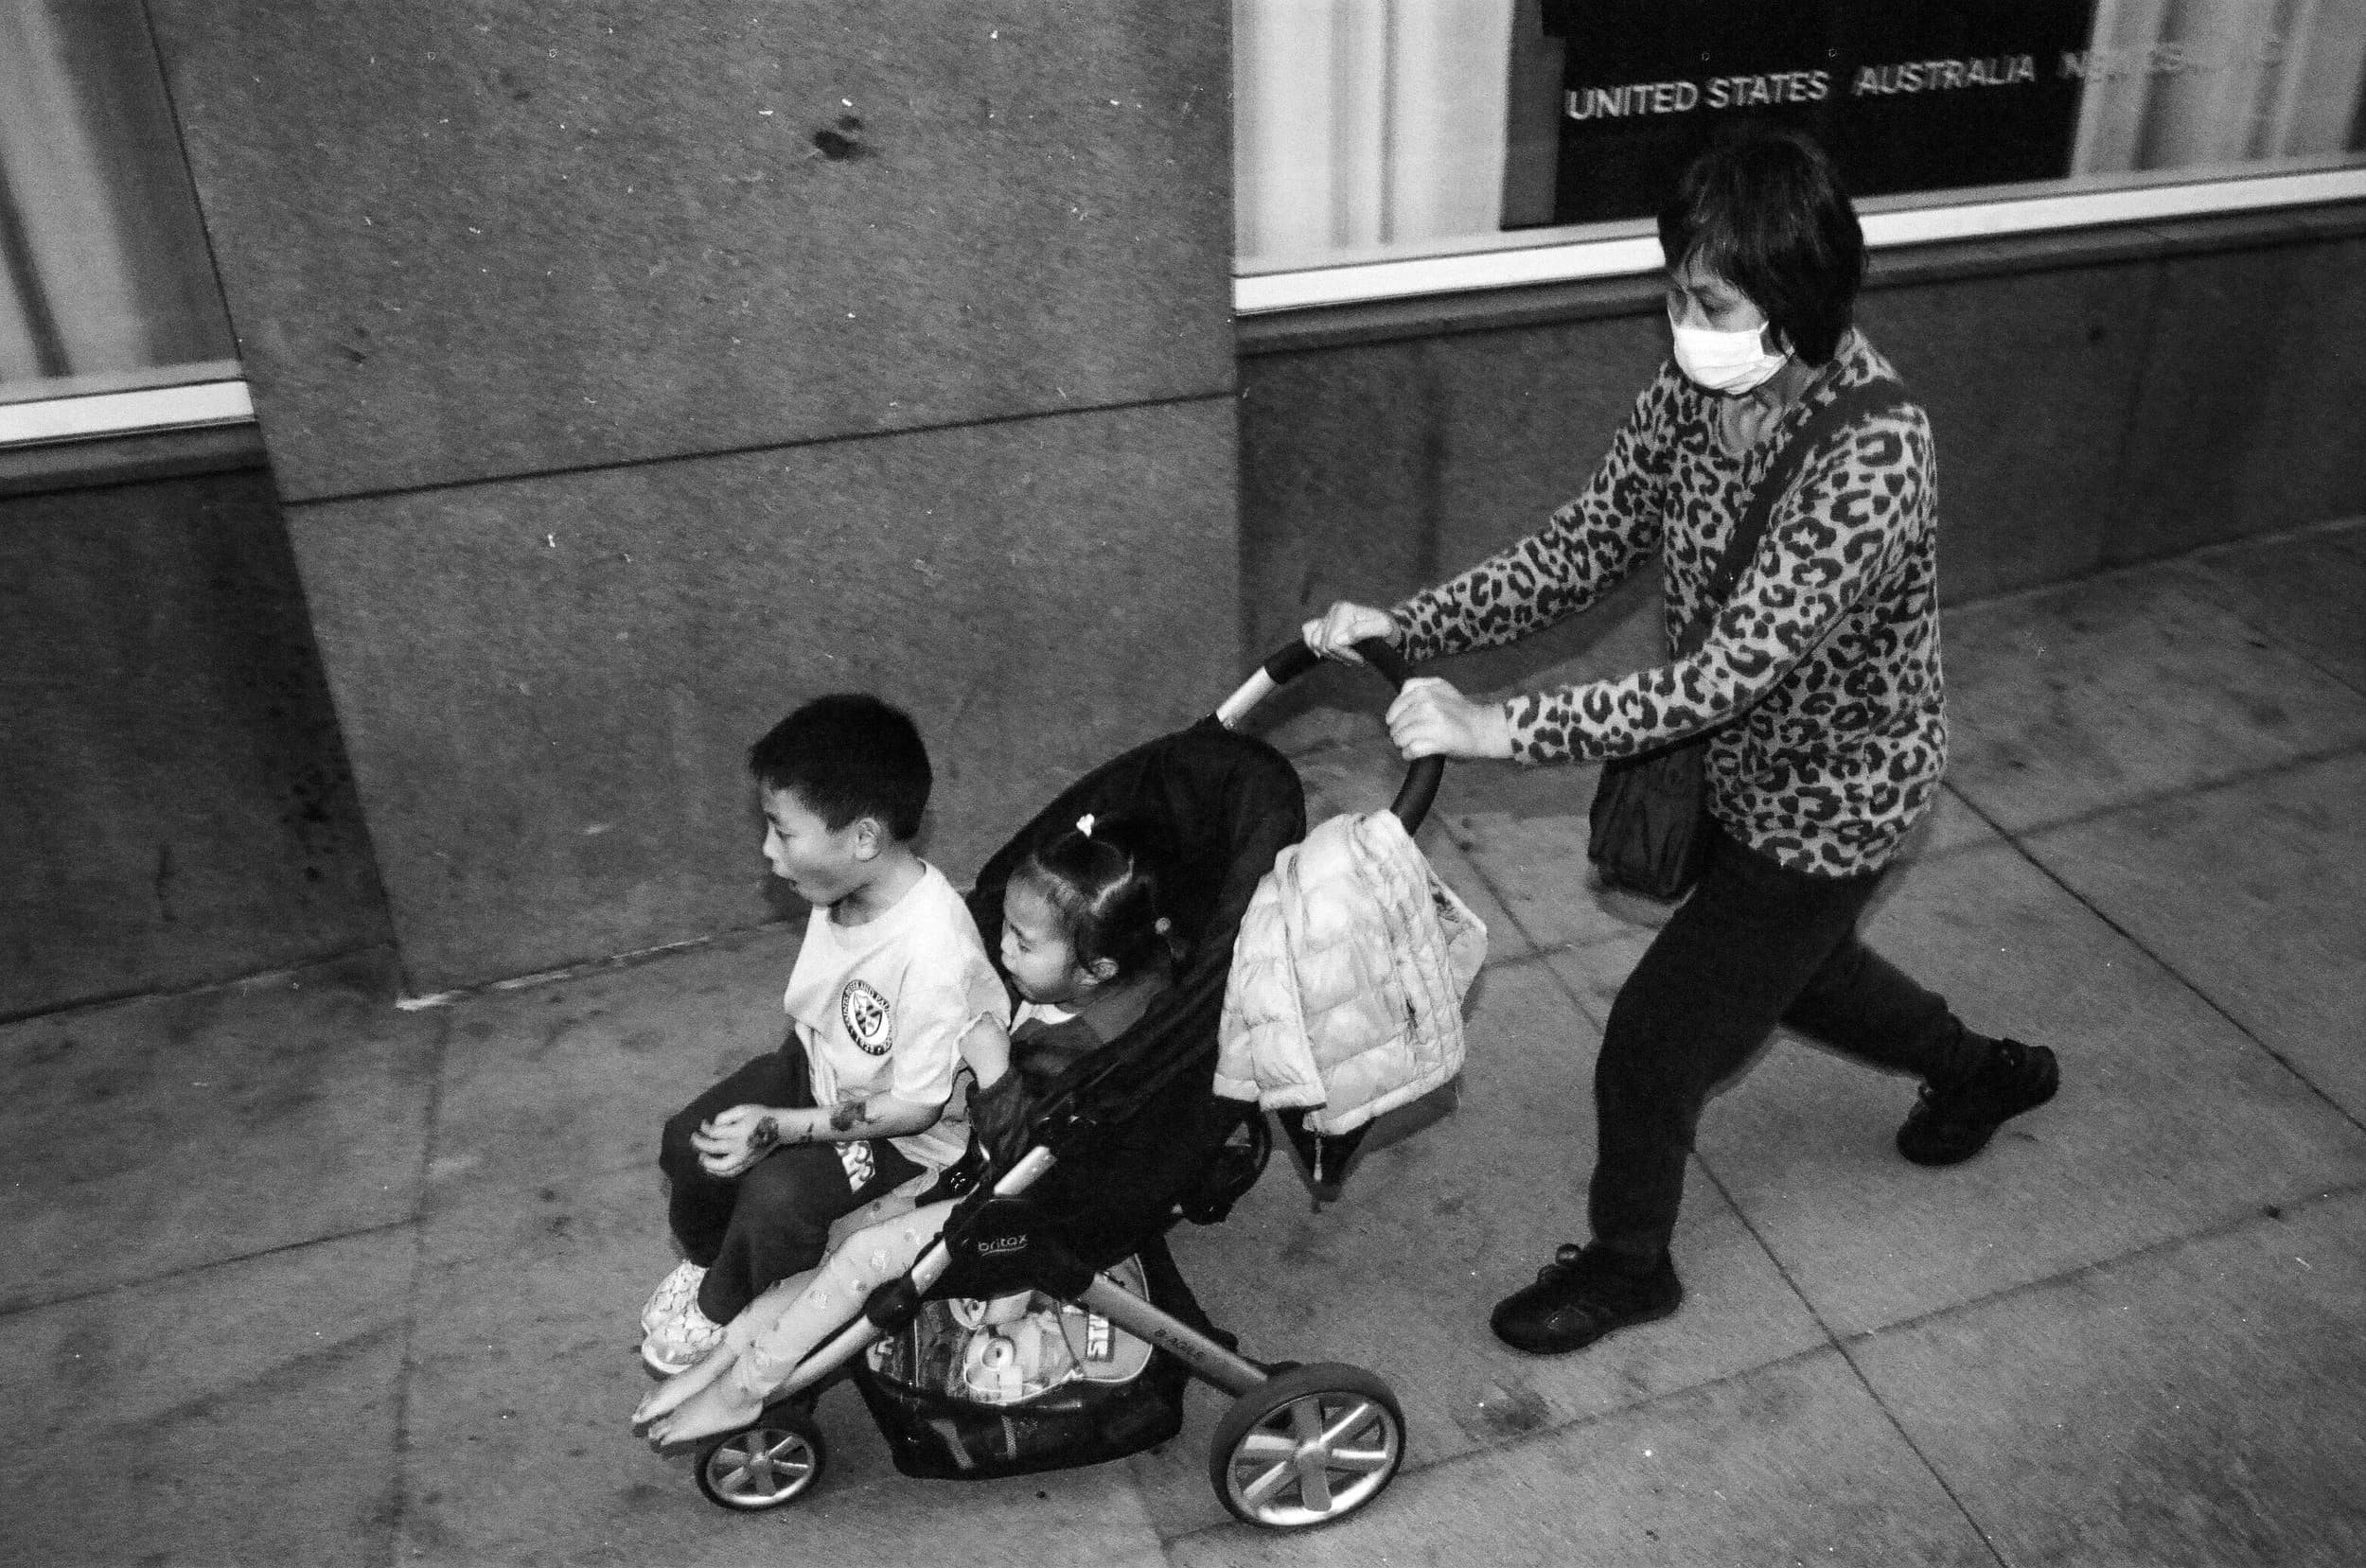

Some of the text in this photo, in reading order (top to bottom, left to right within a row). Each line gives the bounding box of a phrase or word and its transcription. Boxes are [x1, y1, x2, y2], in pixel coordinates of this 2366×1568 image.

[1564, 81, 1698, 120] UNITED
[1706, 70, 1829, 108] STATES
[1853, 54, 2035, 96] AUSTRALIA
[978, 1234, 1029, 1253] britax
